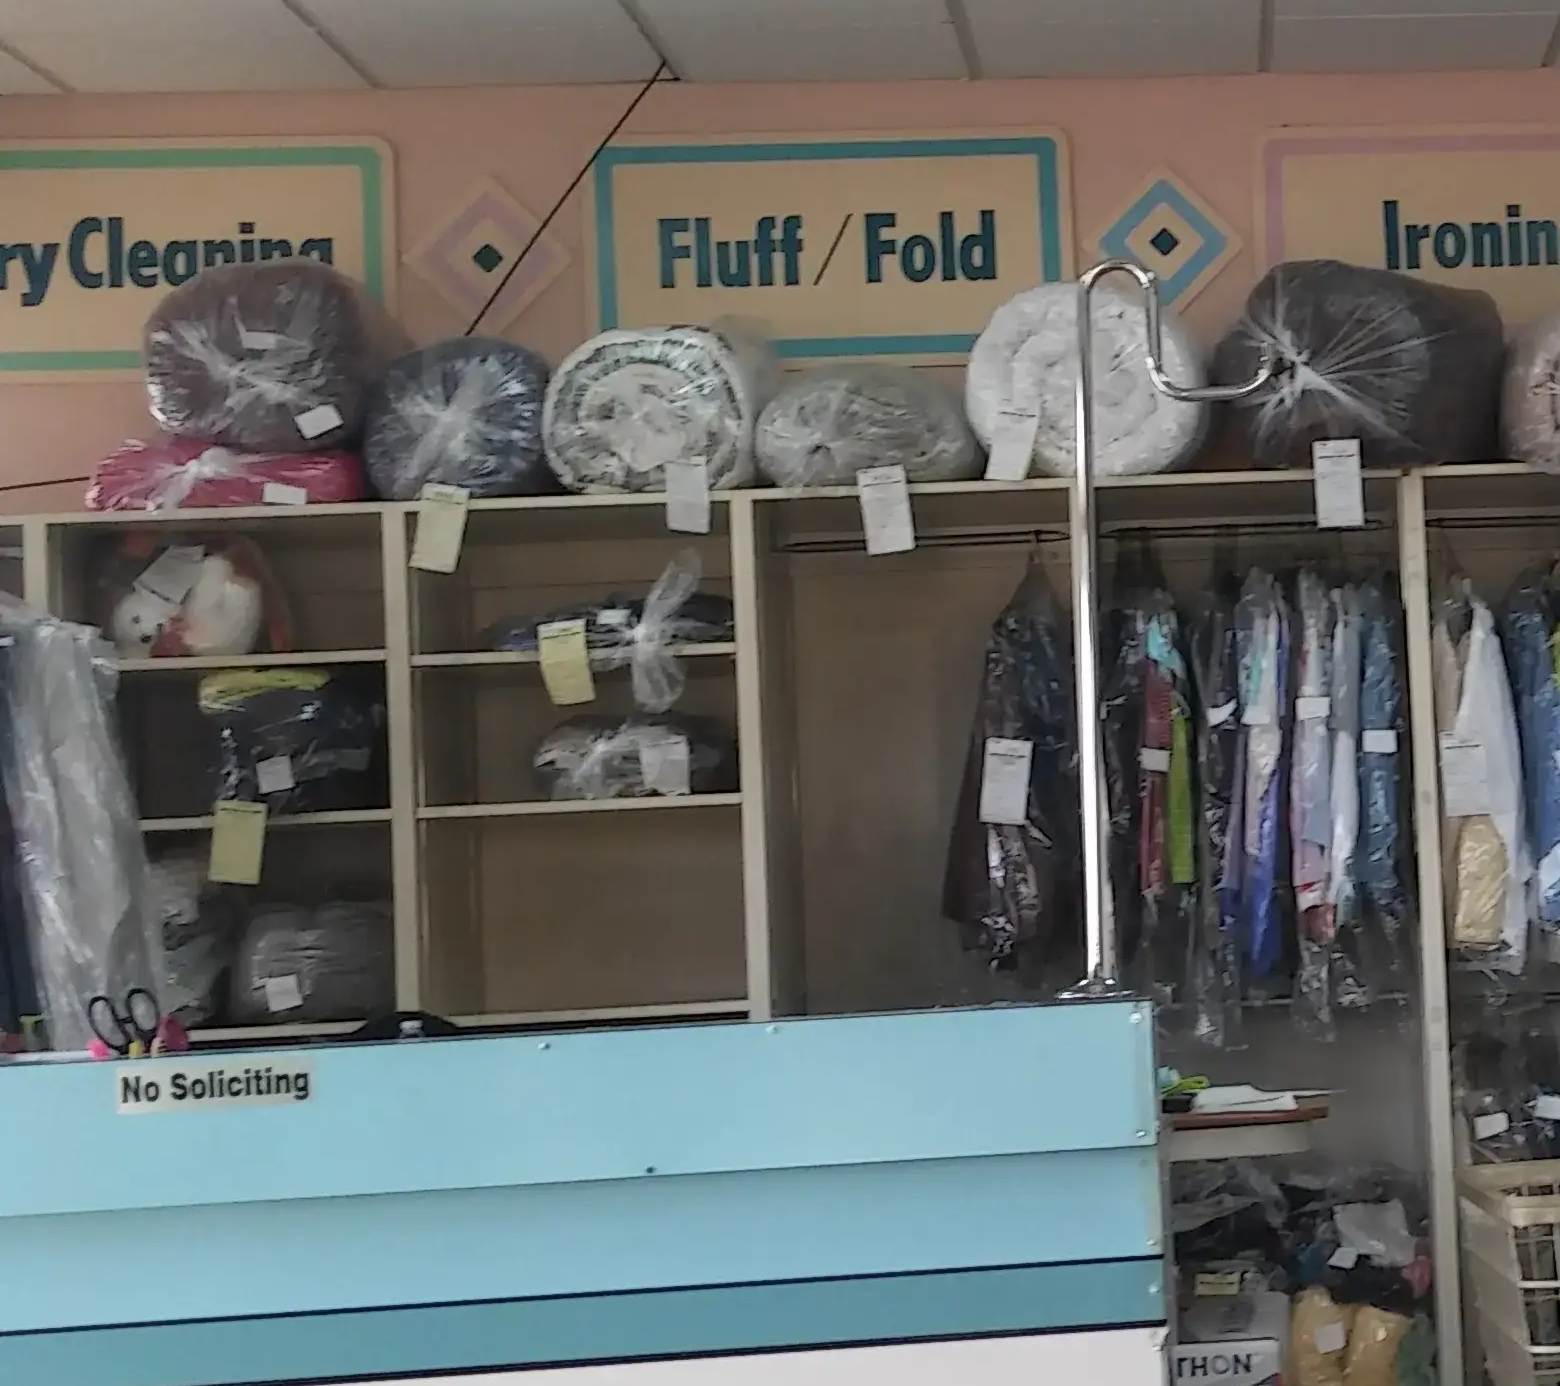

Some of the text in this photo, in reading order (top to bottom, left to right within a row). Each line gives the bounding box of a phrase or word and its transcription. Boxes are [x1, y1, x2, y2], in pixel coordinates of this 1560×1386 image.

[0, 242, 60, 307] ry
[658, 215, 804, 289] Fluff
[864, 209, 998, 284] Fold
[120, 1067, 310, 1104] No Soliciting
